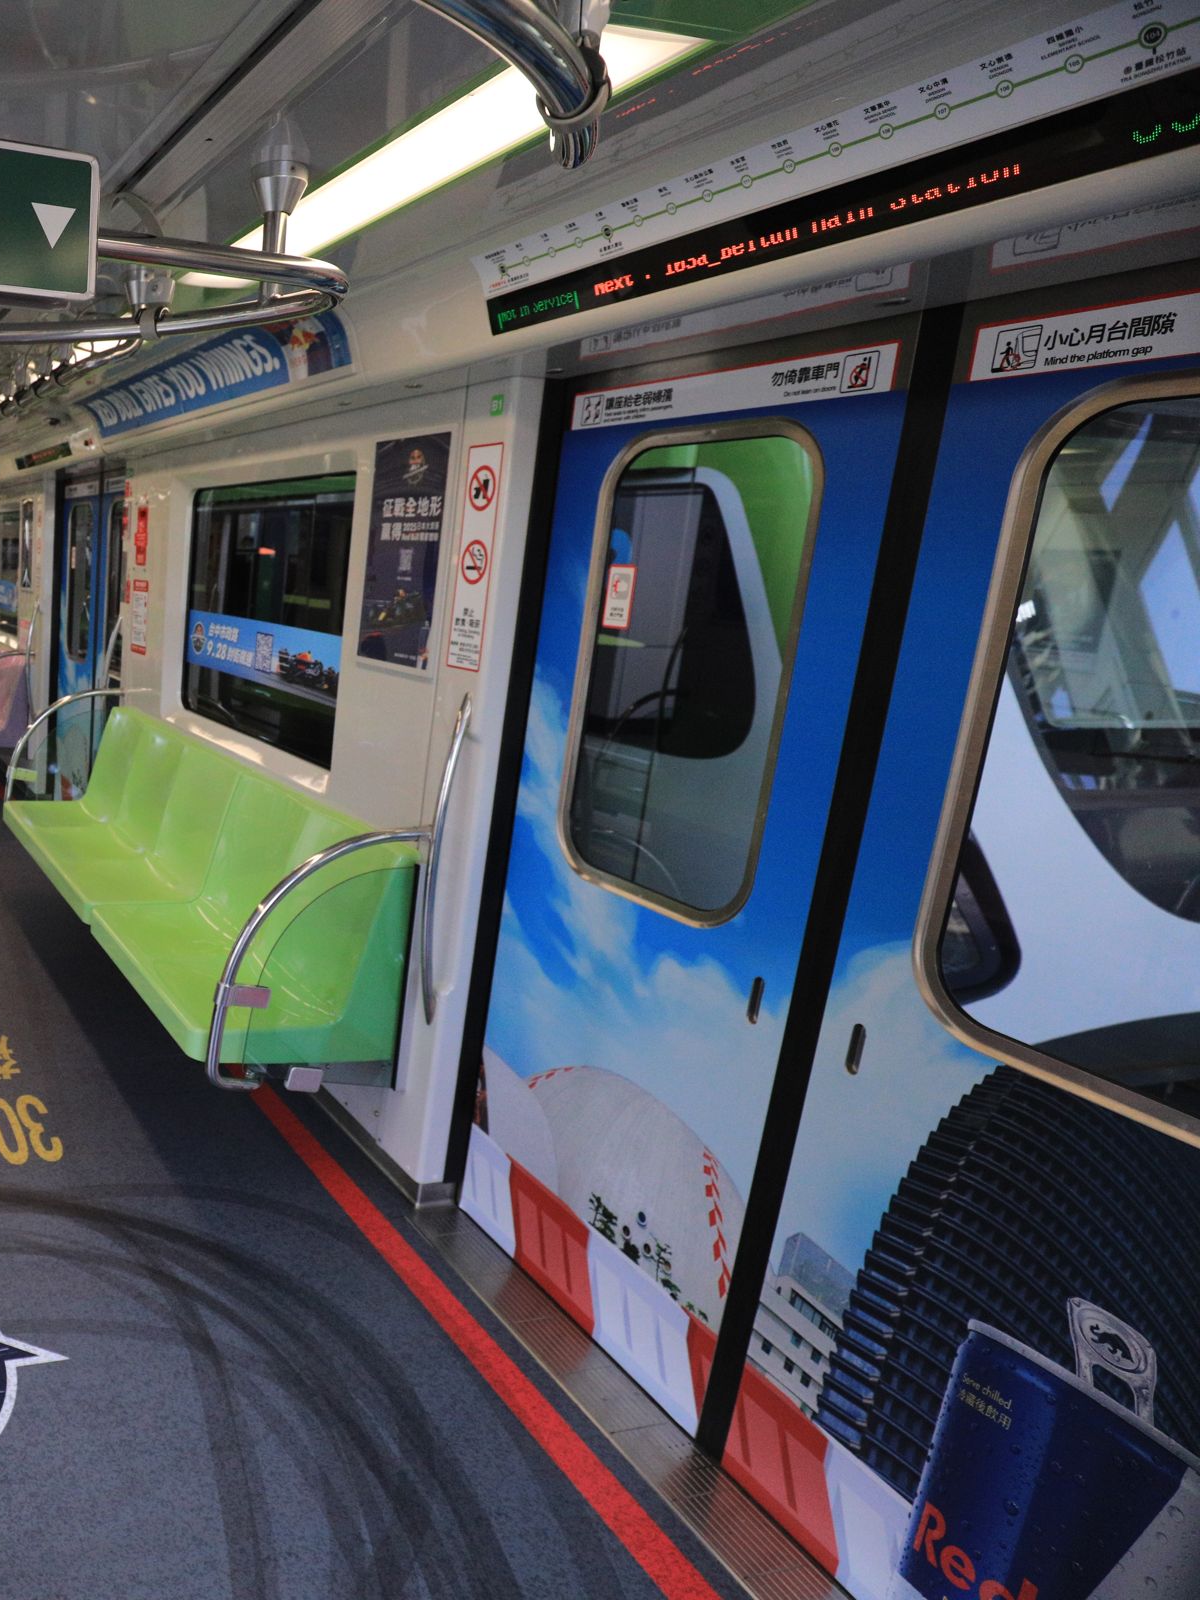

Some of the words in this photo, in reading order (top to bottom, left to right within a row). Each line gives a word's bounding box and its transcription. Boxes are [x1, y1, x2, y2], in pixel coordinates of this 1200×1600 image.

[1043, 311, 1178, 352] 小心月台間隙
[1043, 356, 1068, 368] Mind
[1069, 353, 1086, 364] the
[1086, 349, 1130, 363] platform
[1131, 345, 1153, 357] gap
[129, 375, 176, 413] GIVES
[162, 361, 207, 400] YOU
[771, 361, 840, 387] 勿倚靠車門
[382, 495, 442, 518] 征戰全地形
[206, 640, 227, 661] 9.28
[958, 1388, 1012, 1431] 冷藏後飲用
